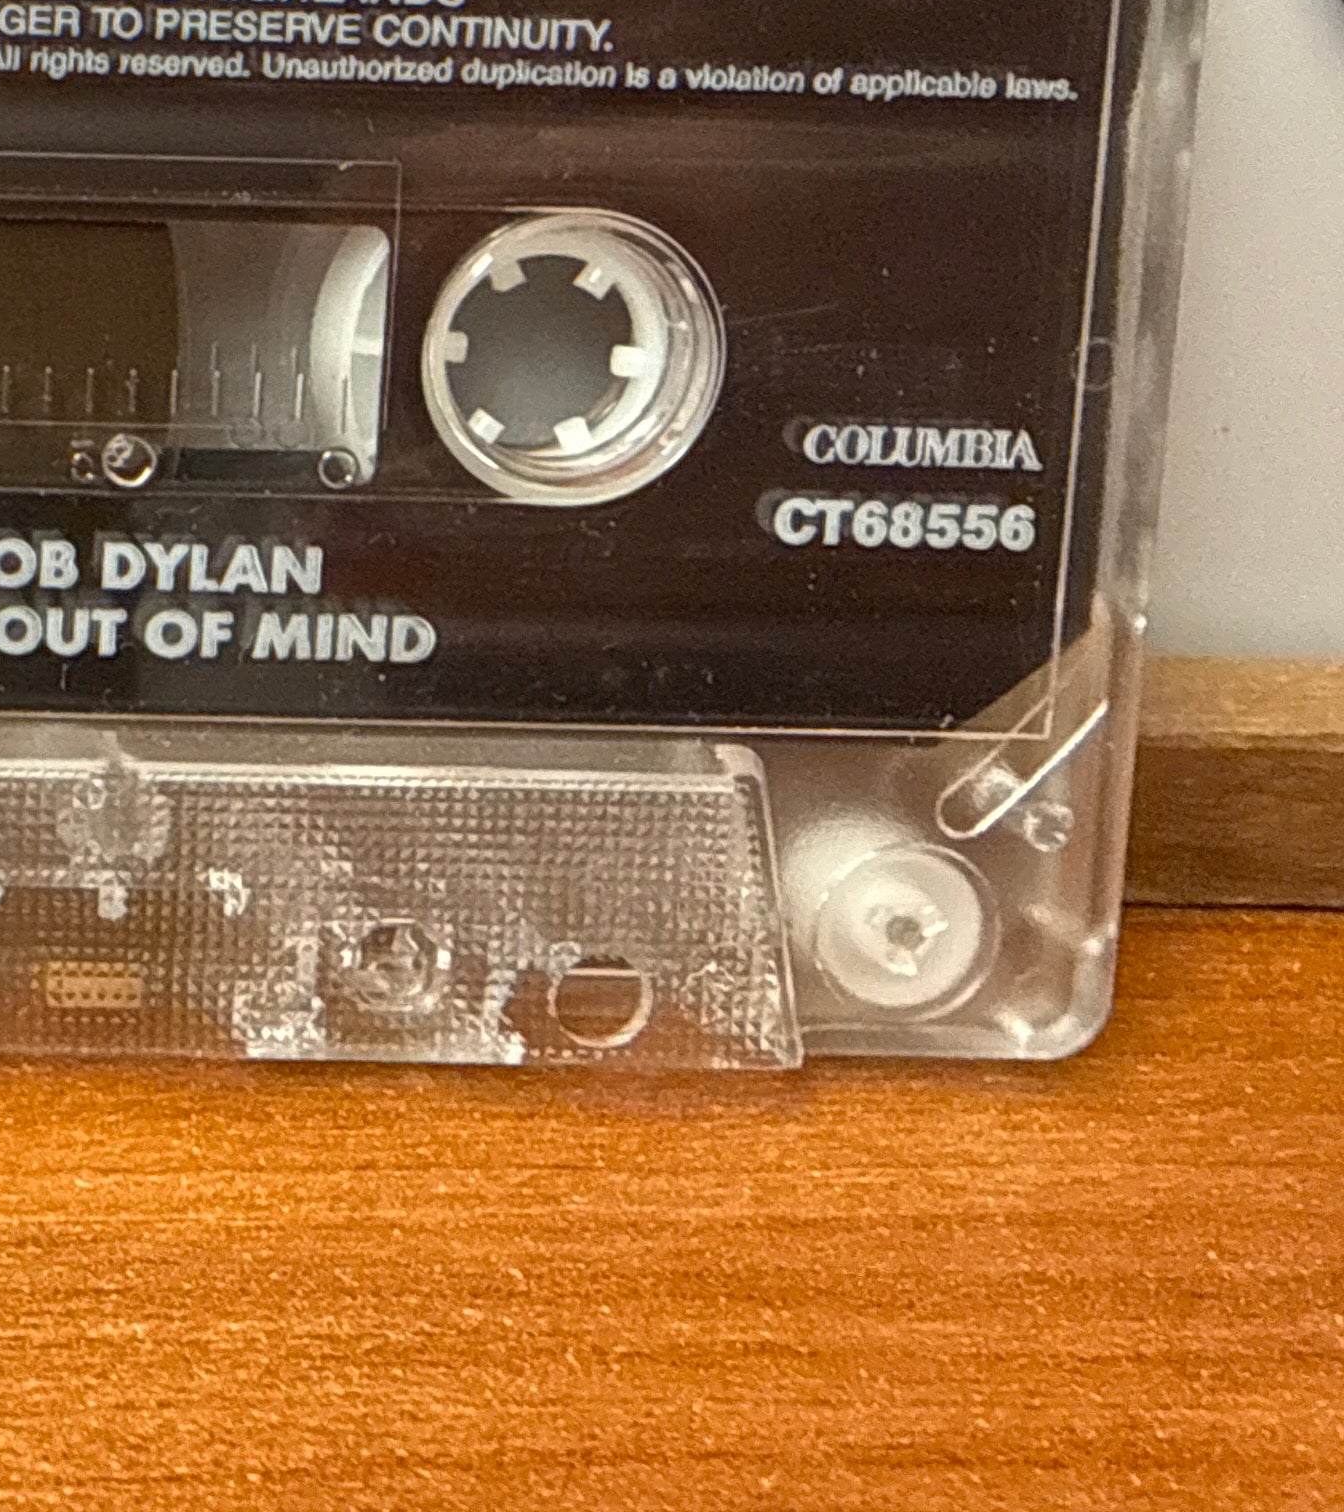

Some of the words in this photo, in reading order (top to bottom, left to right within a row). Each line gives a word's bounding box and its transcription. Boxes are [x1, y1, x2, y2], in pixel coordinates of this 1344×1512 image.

[92, 5, 143, 40] TO
[154, 7, 362, 45] PRESERVE
[373, 11, 613, 53] CONTINUITY.
[29, 44, 110, 80] rights
[118, 50, 252, 79] reserved.
[261, 51, 453, 83] Unauthorized
[460, 56, 616, 90] duplication
[624, 62, 651, 89] is
[656, 68, 677, 90] a
[685, 64, 806, 94] violation
[813, 67, 843, 94] of
[849, 70, 998, 101] applicable
[1005, 72, 1079, 101] laws.
[802, 423, 1044, 472] COLUMBIA
[773, 497, 1036, 552] CT68556
[100, 540, 324, 595] DYLAN
[143, 609, 235, 659] OF
[251, 612, 438, 664] MIND
